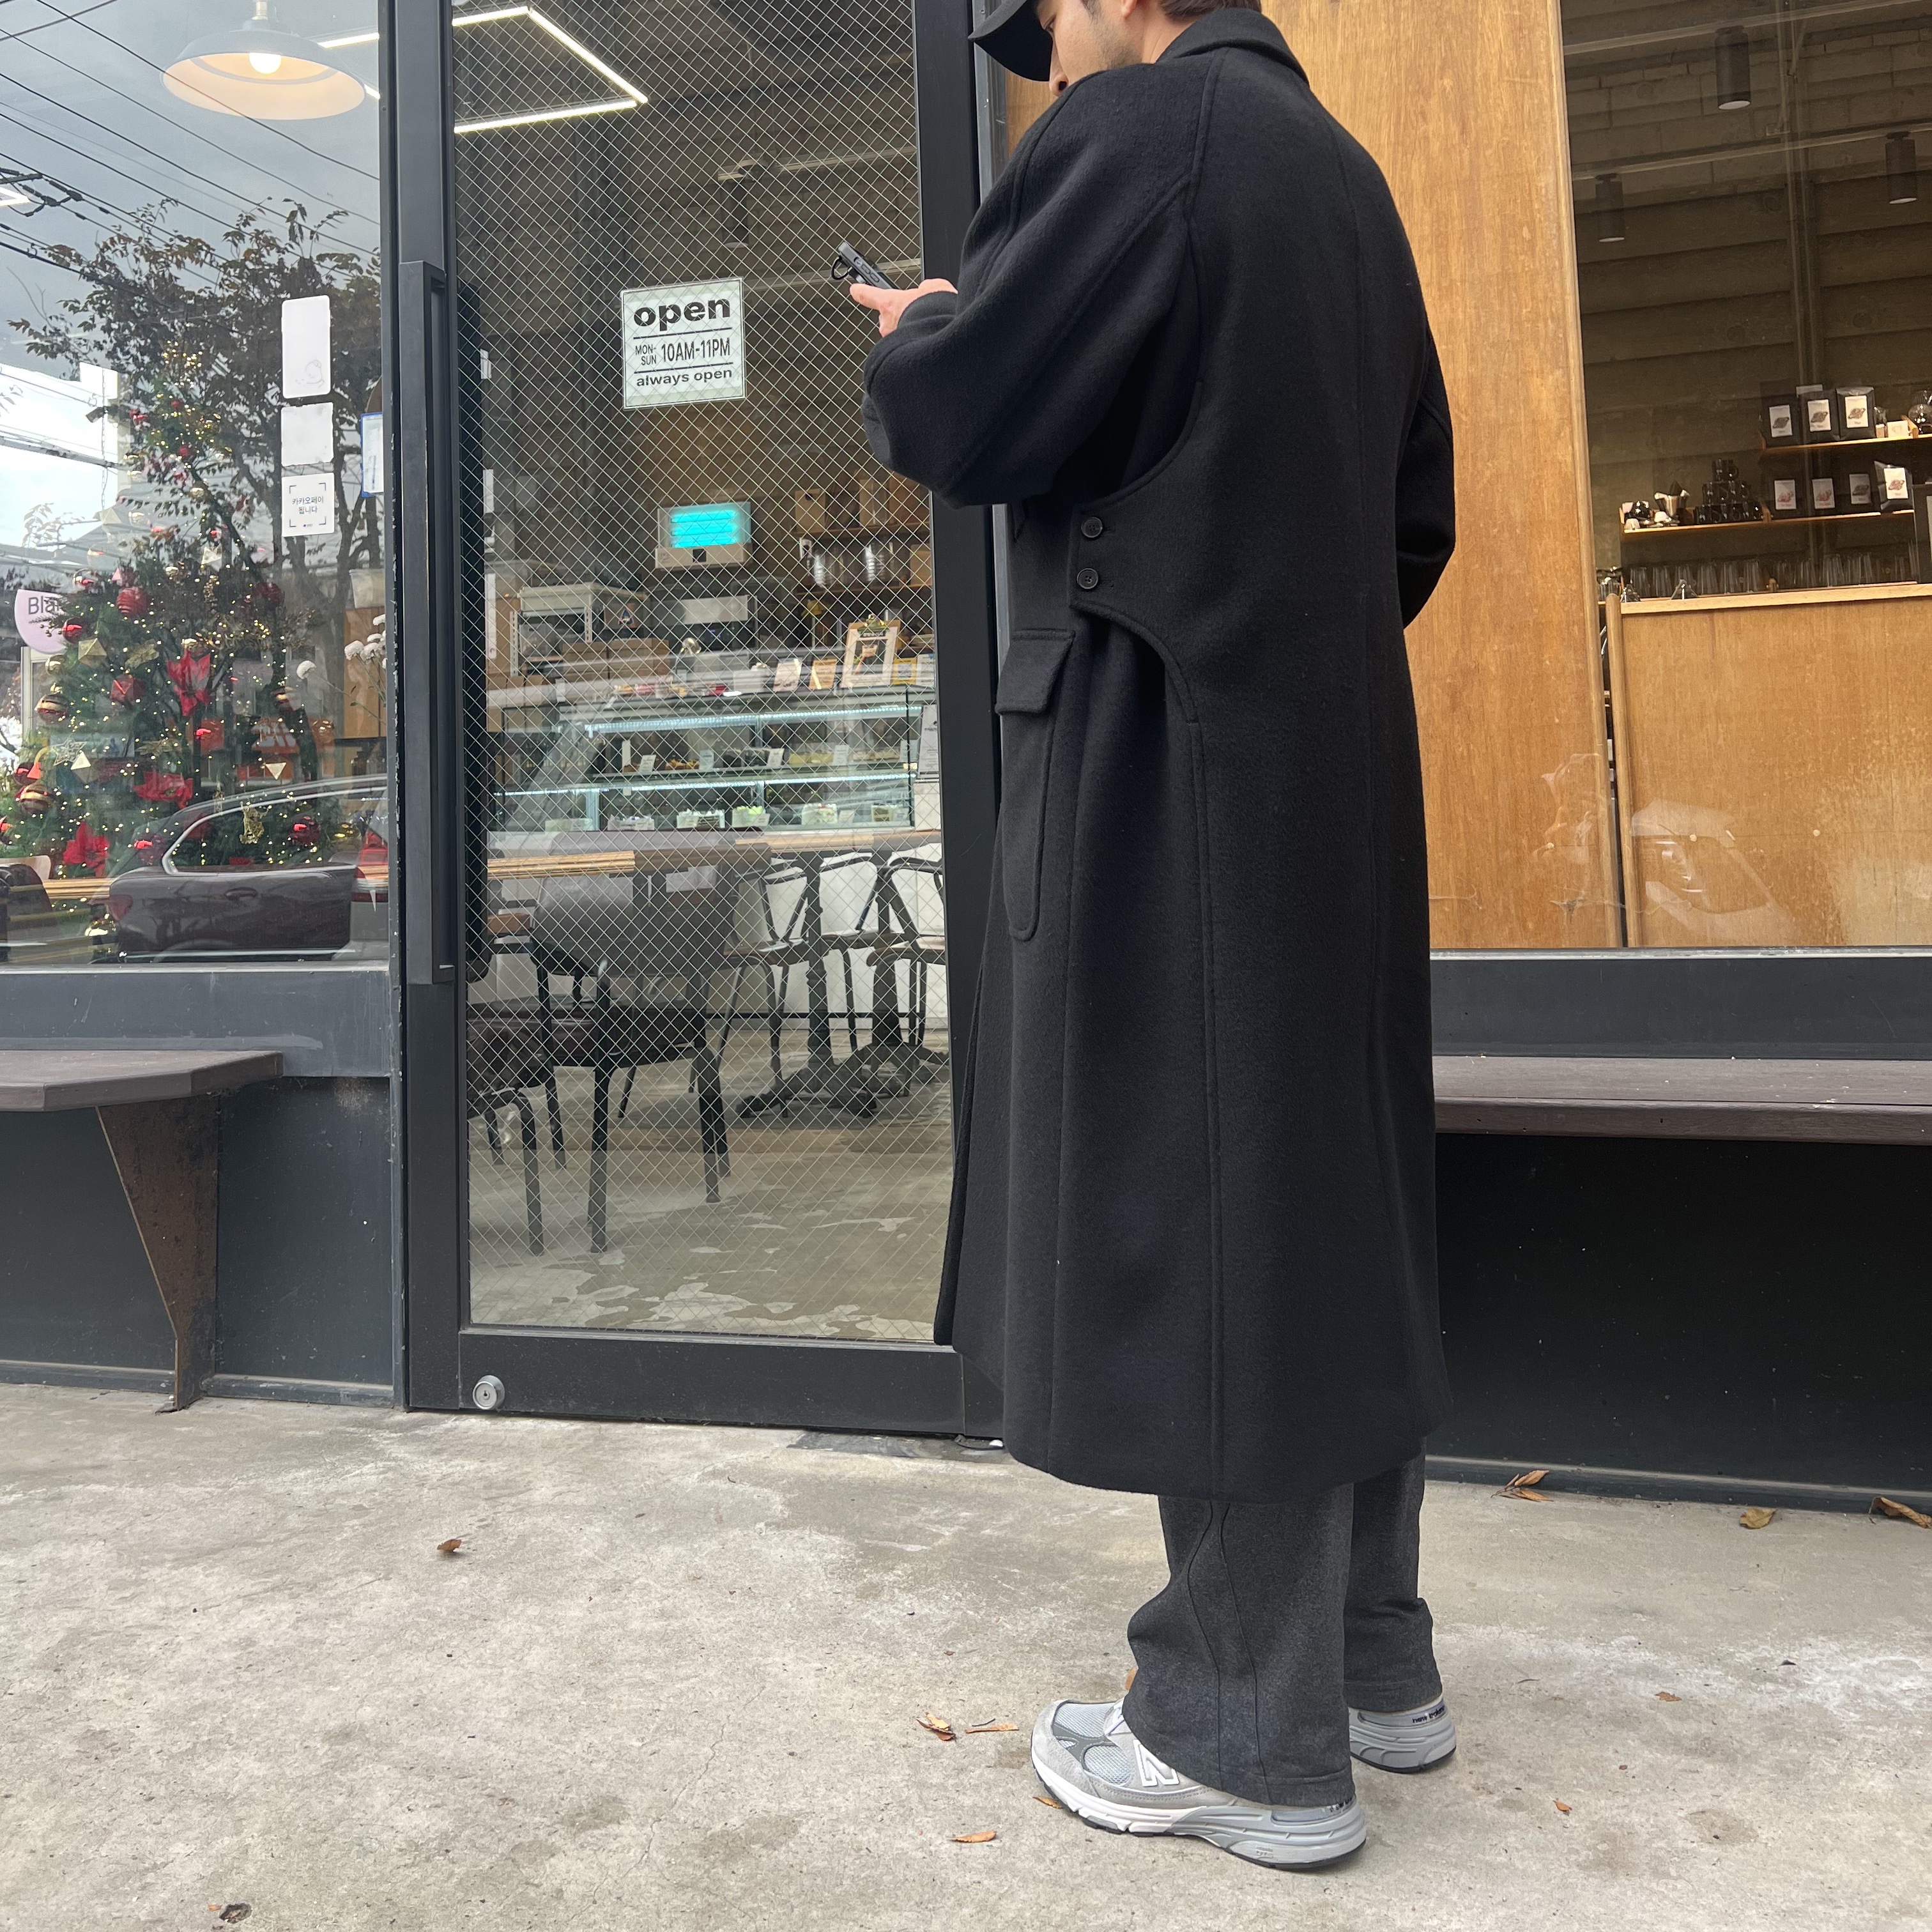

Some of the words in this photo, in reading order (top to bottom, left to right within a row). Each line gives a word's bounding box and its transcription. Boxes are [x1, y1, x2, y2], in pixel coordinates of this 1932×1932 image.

[633, 298, 731, 332] open
[635, 344, 657, 356] MON-
[661, 337, 730, 362] 10AM-11PM
[641, 355, 657, 365] SUN
[636, 373, 690, 386] always
[694, 369, 732, 383] open
[292, 495, 324, 505] 카카오페이
[298, 505, 318, 514] 됩니다
